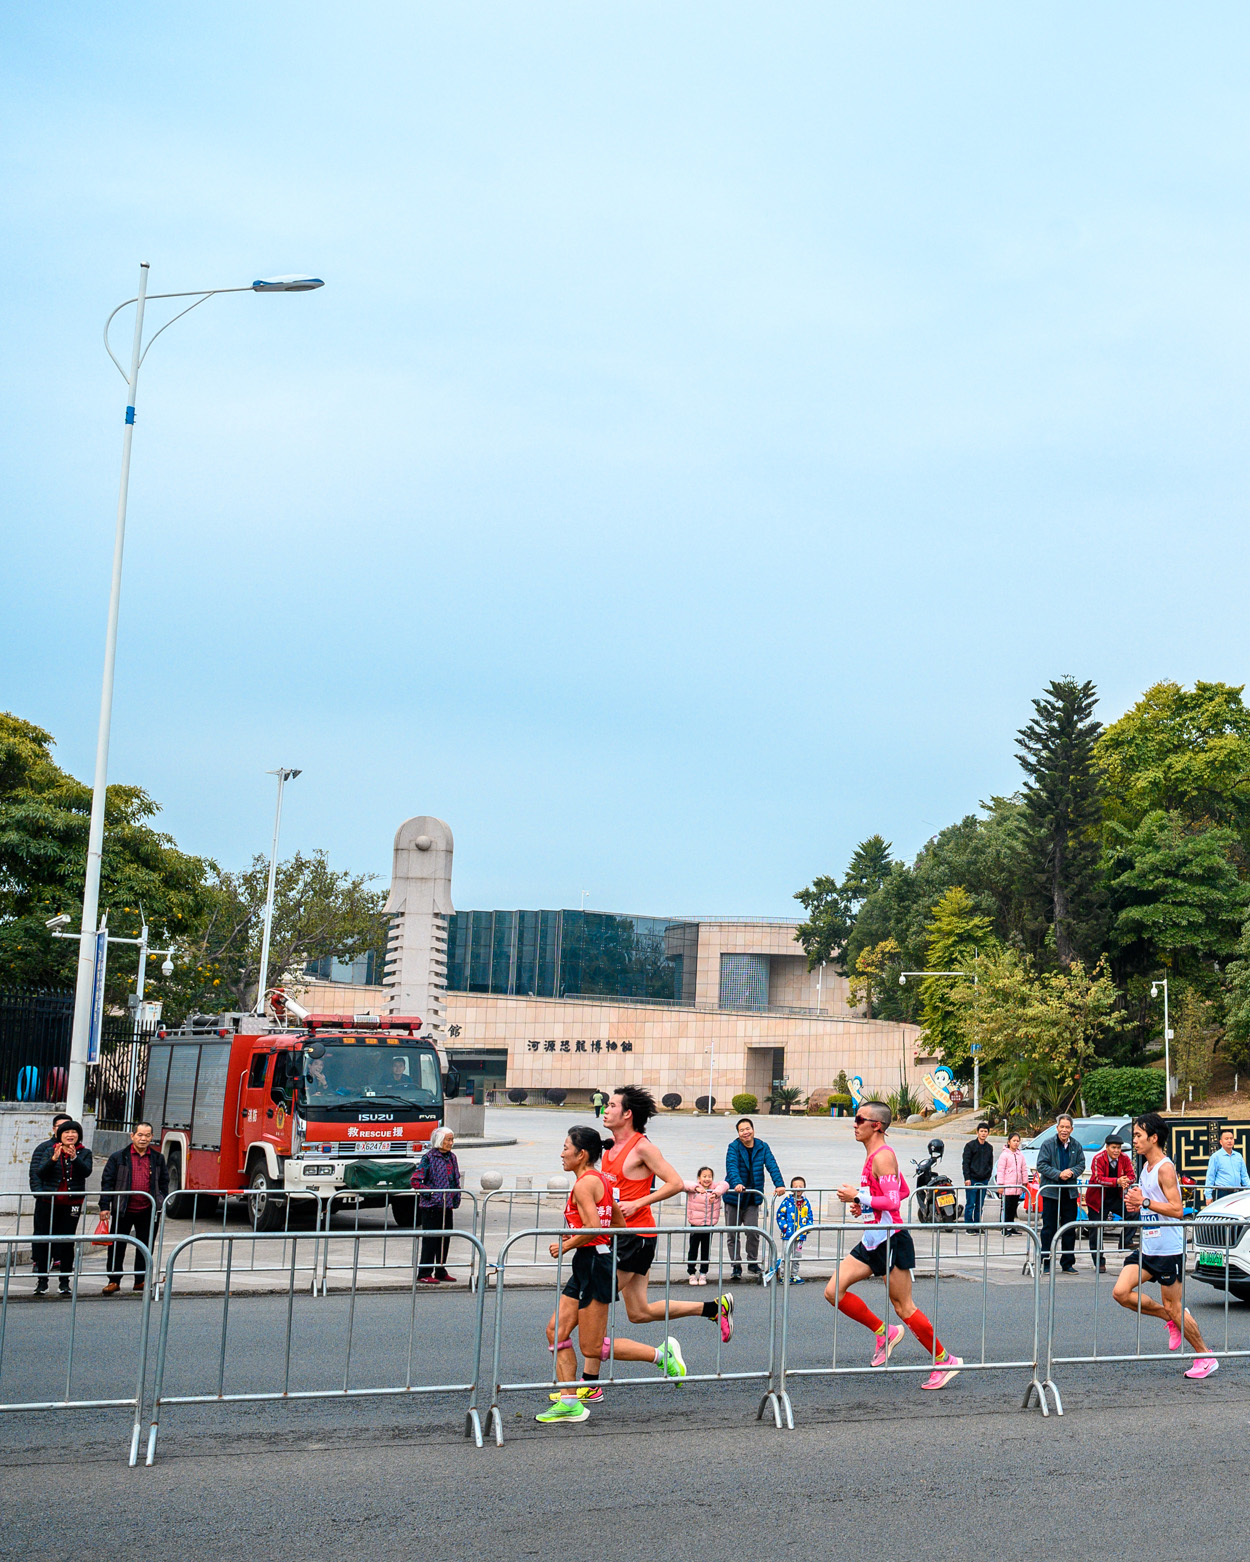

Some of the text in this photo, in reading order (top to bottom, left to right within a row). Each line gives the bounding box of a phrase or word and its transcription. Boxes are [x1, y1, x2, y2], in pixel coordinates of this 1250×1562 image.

[347, 1127, 403, 1138] 救 RESCUE 援
